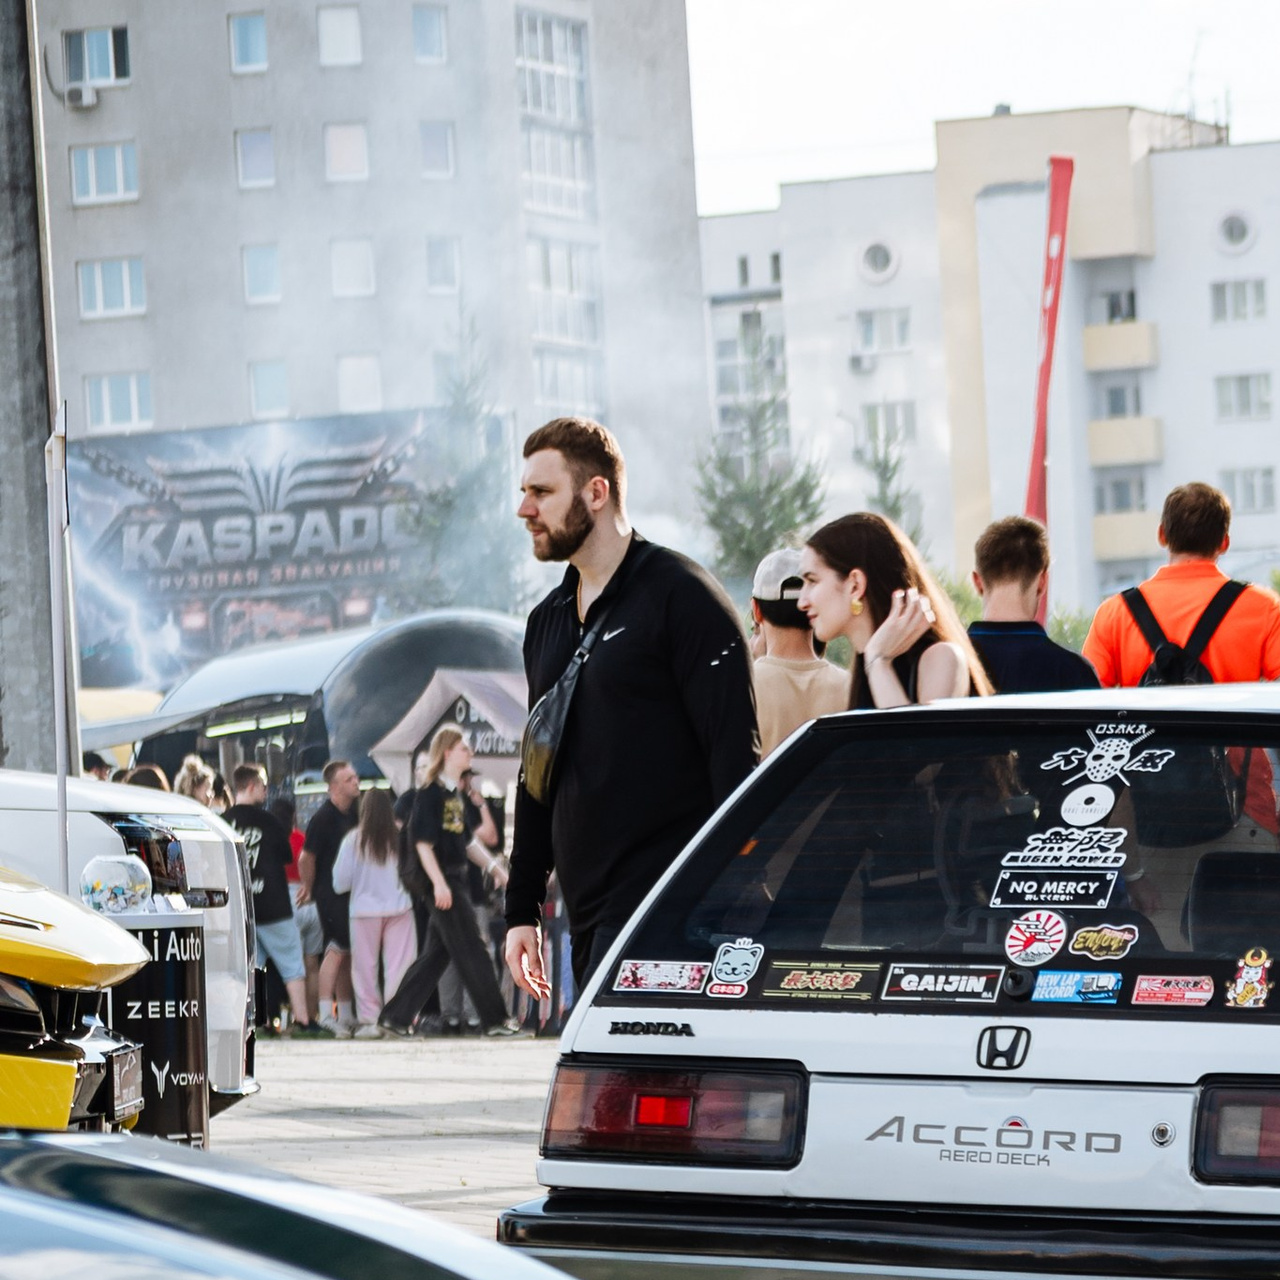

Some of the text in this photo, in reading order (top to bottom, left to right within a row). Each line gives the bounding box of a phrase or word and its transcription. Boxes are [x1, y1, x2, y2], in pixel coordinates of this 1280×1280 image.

[1095, 723, 1148, 734] OSAKA
[1065, 855, 1123, 865] POWER
[1009, 881, 1100, 895] NO MERCY
[165, 930, 202, 962] Auto
[1037, 973, 1081, 988] NEW LAP
[1034, 987, 1076, 999] RECORD!
[126, 1000, 200, 1019] ZEEKR
[608, 1021, 695, 1037] HONDA
[939, 1149, 1050, 1167] AERO DECK
